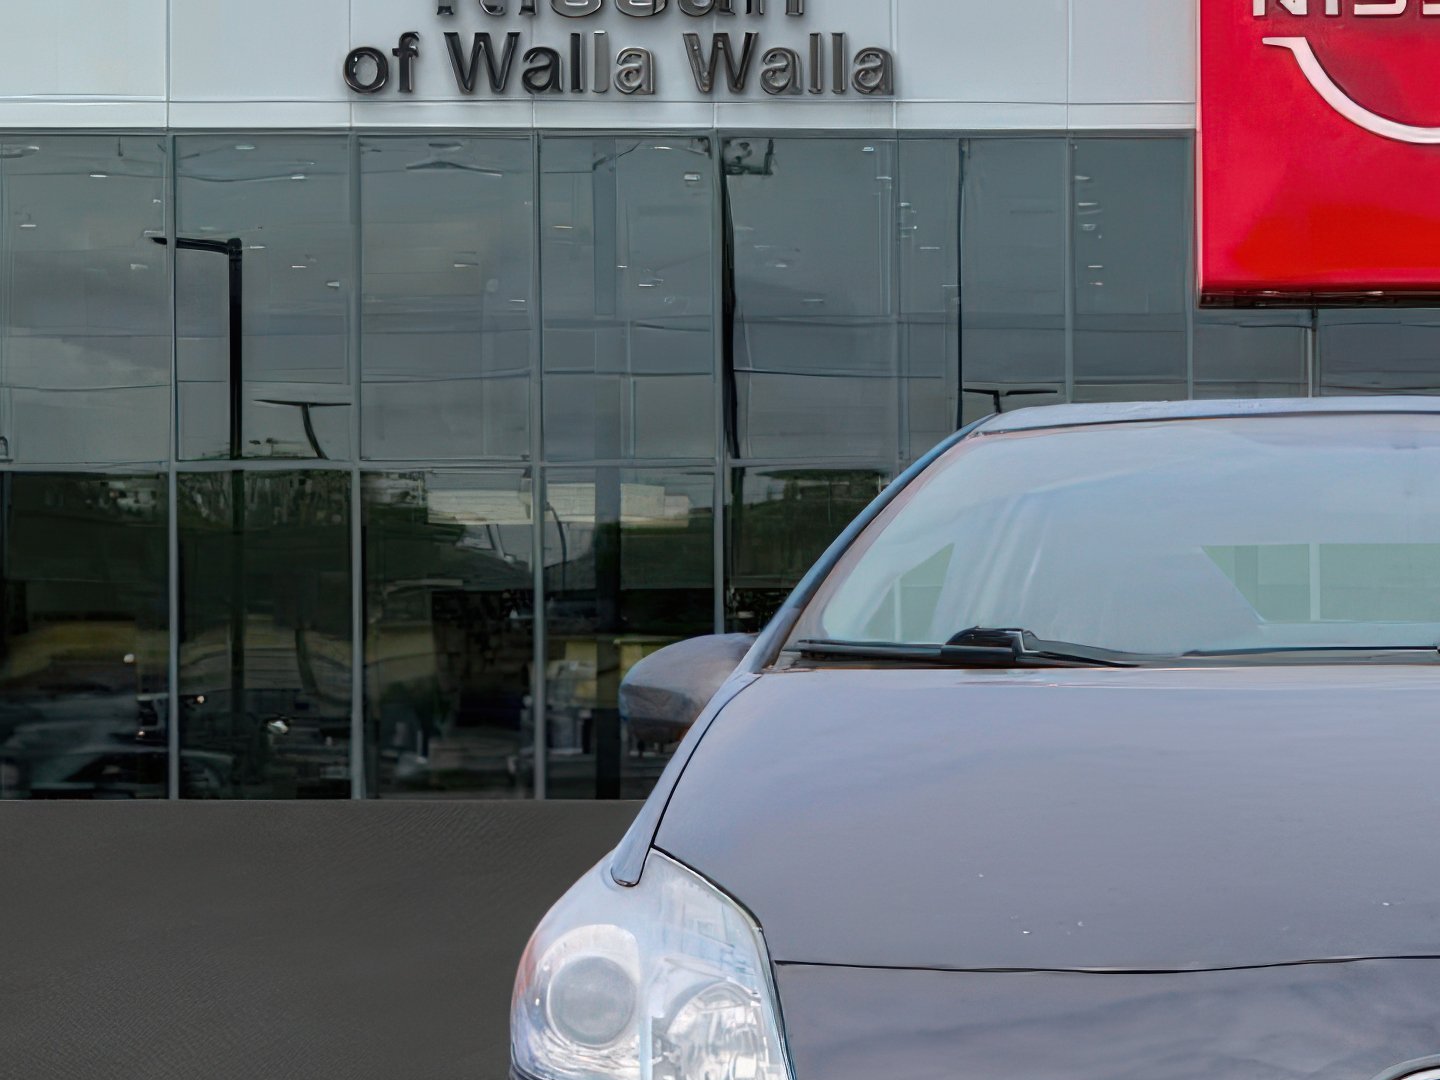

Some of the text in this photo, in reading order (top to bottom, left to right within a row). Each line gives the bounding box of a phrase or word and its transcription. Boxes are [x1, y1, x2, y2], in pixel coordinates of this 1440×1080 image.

[342, 31, 895, 96] of Walla Walla
